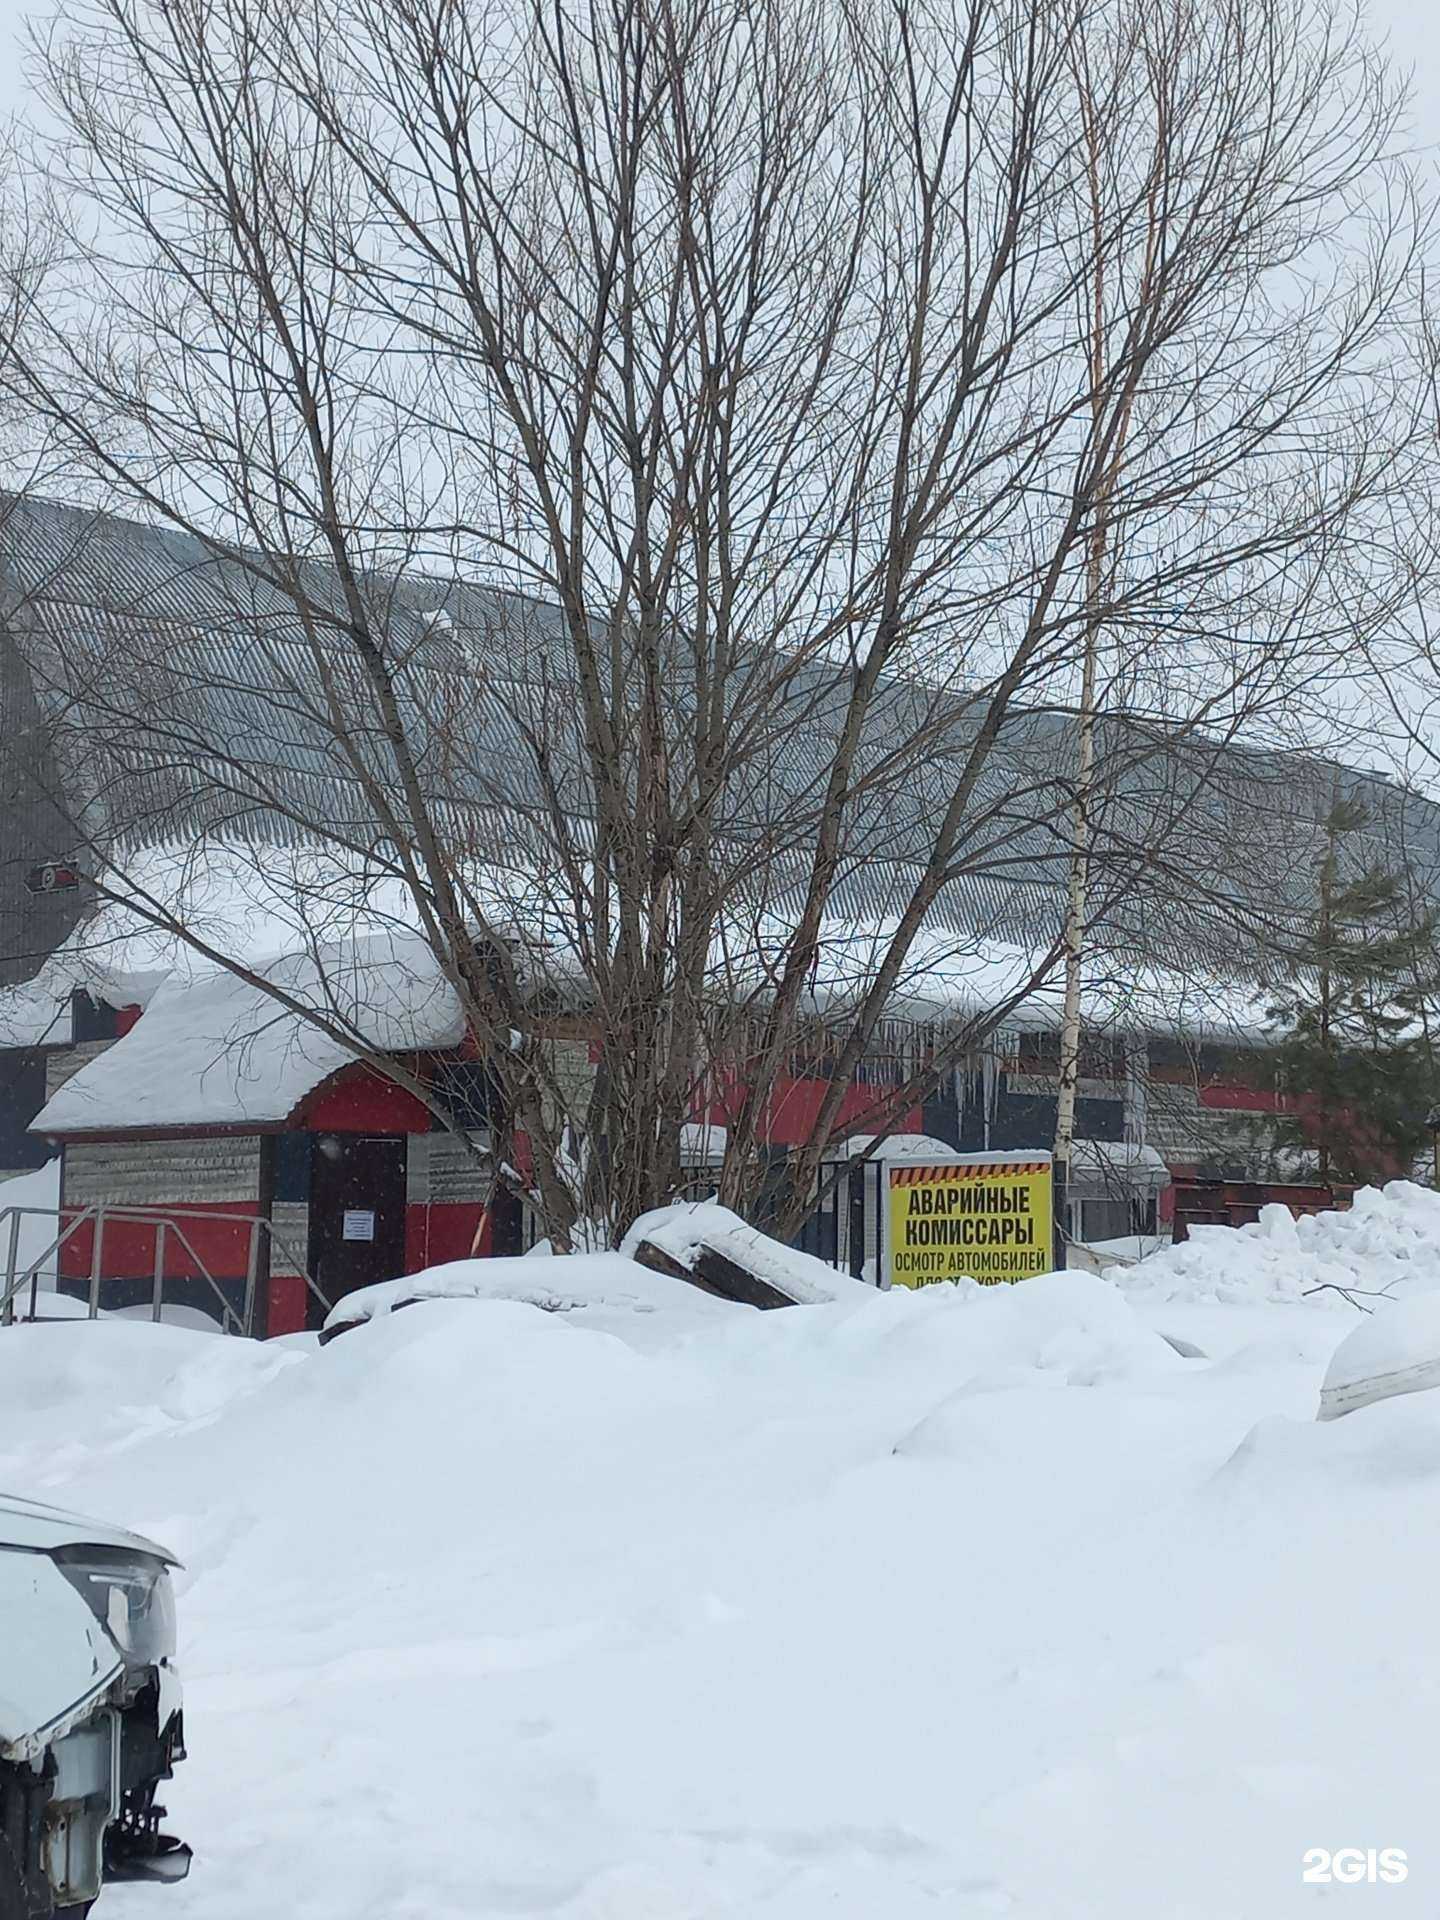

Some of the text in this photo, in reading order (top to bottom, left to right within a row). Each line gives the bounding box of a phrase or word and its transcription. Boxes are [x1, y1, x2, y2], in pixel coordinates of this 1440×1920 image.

[908, 1182, 1030, 1215] АВАРИЙНЫЕ
[905, 1218, 1034, 1246] КОМИССАРЫ
[895, 1248, 1045, 1271] ОСМОТР АВТОМОБИЛЕЙ
